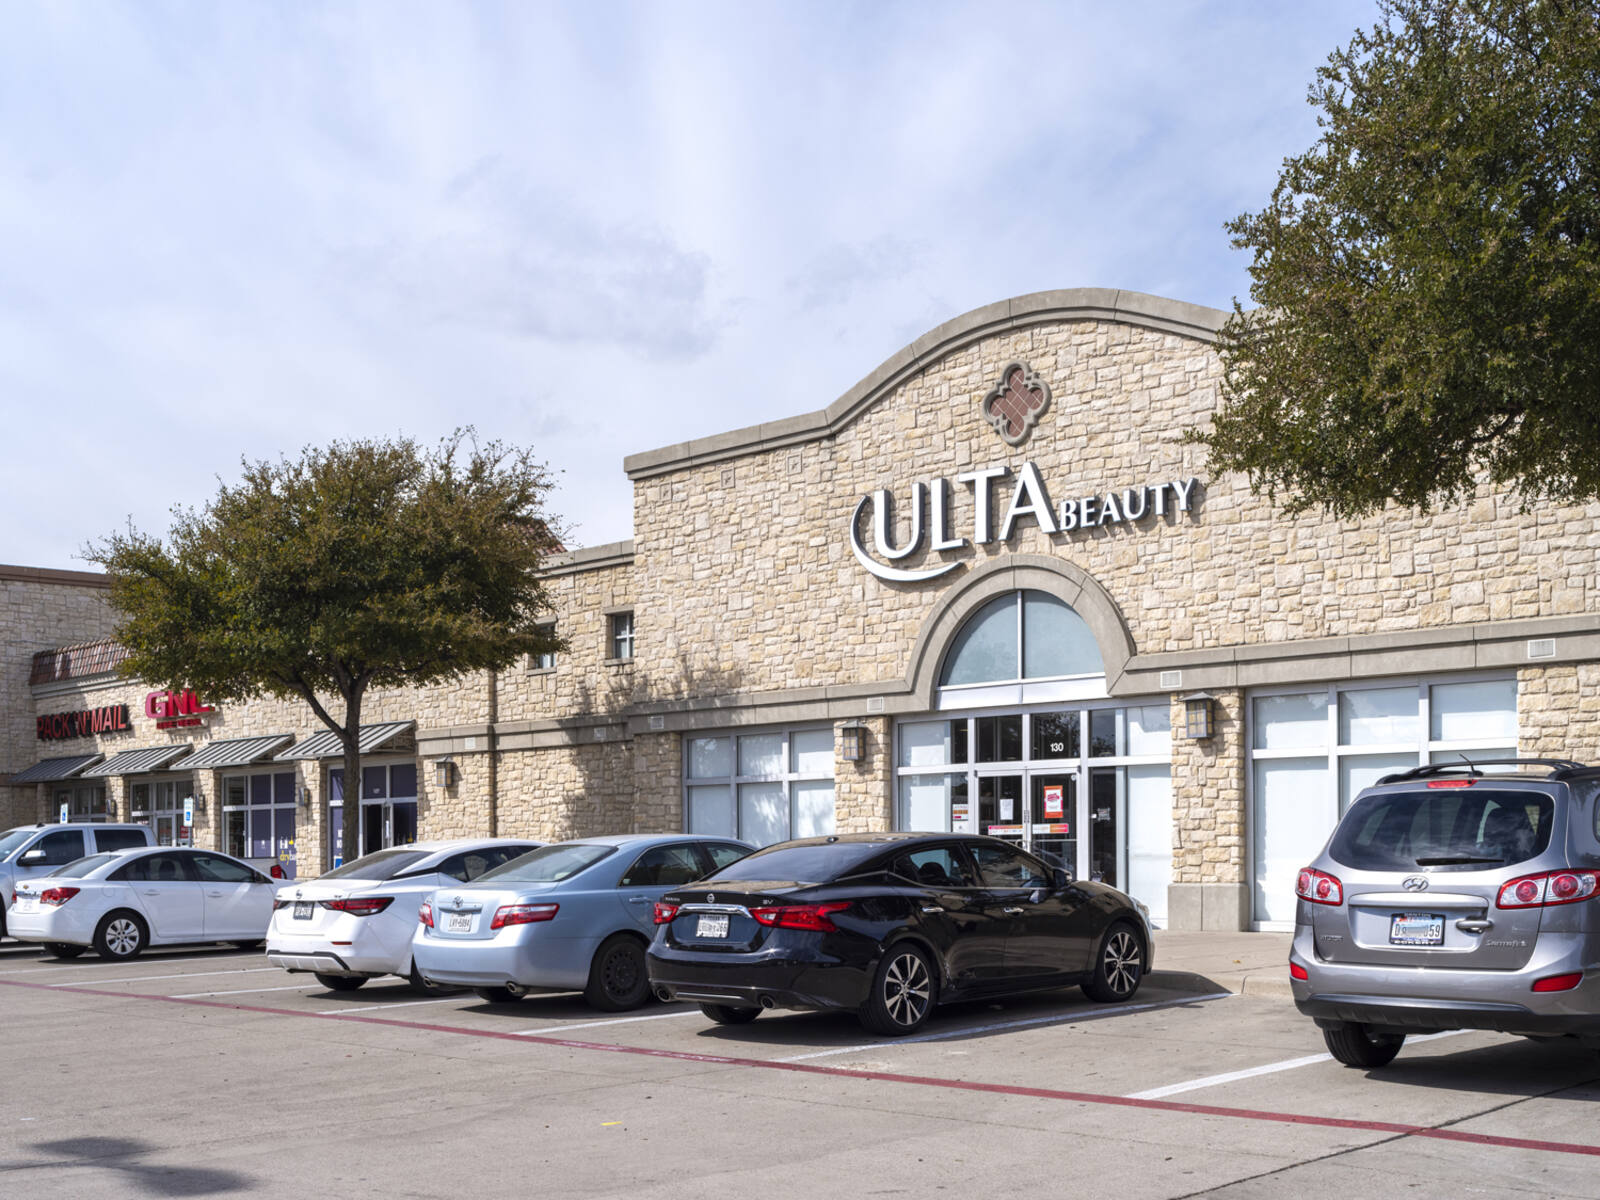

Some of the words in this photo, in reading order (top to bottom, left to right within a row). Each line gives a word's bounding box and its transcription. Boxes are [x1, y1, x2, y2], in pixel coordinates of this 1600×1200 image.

[874, 461, 1058, 560] ULTA
[1060, 477, 1198, 532] BEAUTY
[36, 713, 71, 740] PACK
[1050, 742, 1064, 752] 130
